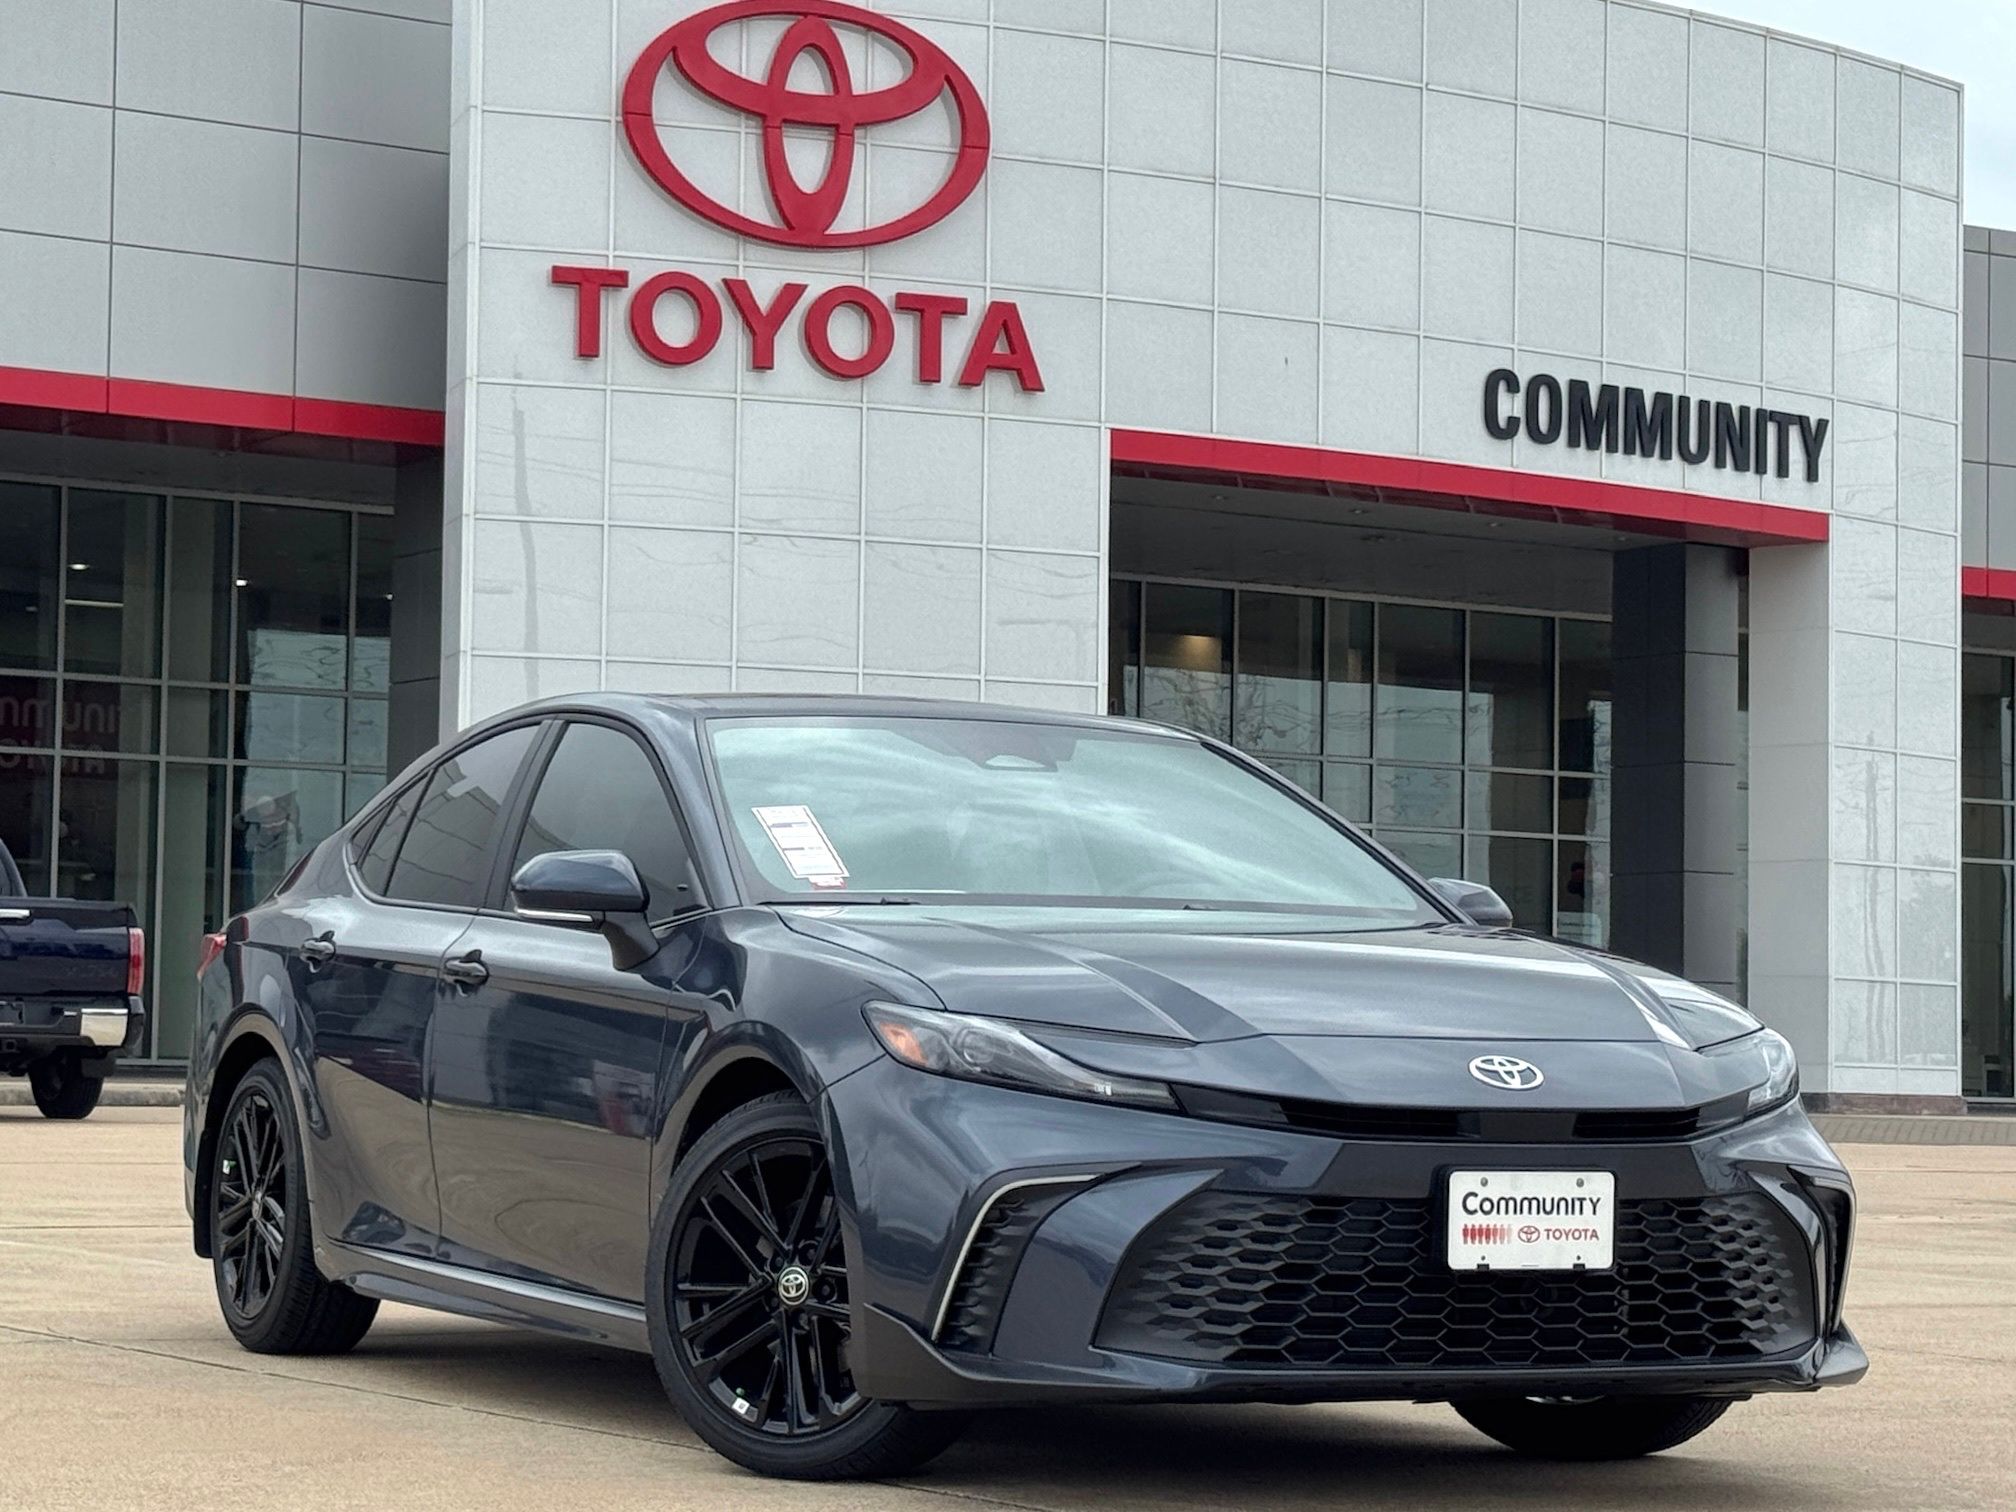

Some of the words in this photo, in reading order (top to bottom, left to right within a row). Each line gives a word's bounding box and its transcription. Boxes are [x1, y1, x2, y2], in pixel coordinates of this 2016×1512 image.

[551, 265, 1045, 392] TOYOTA
[1484, 369, 1829, 482] COMMUNITY
[1544, 1228, 1599, 1241] TOYOTA
